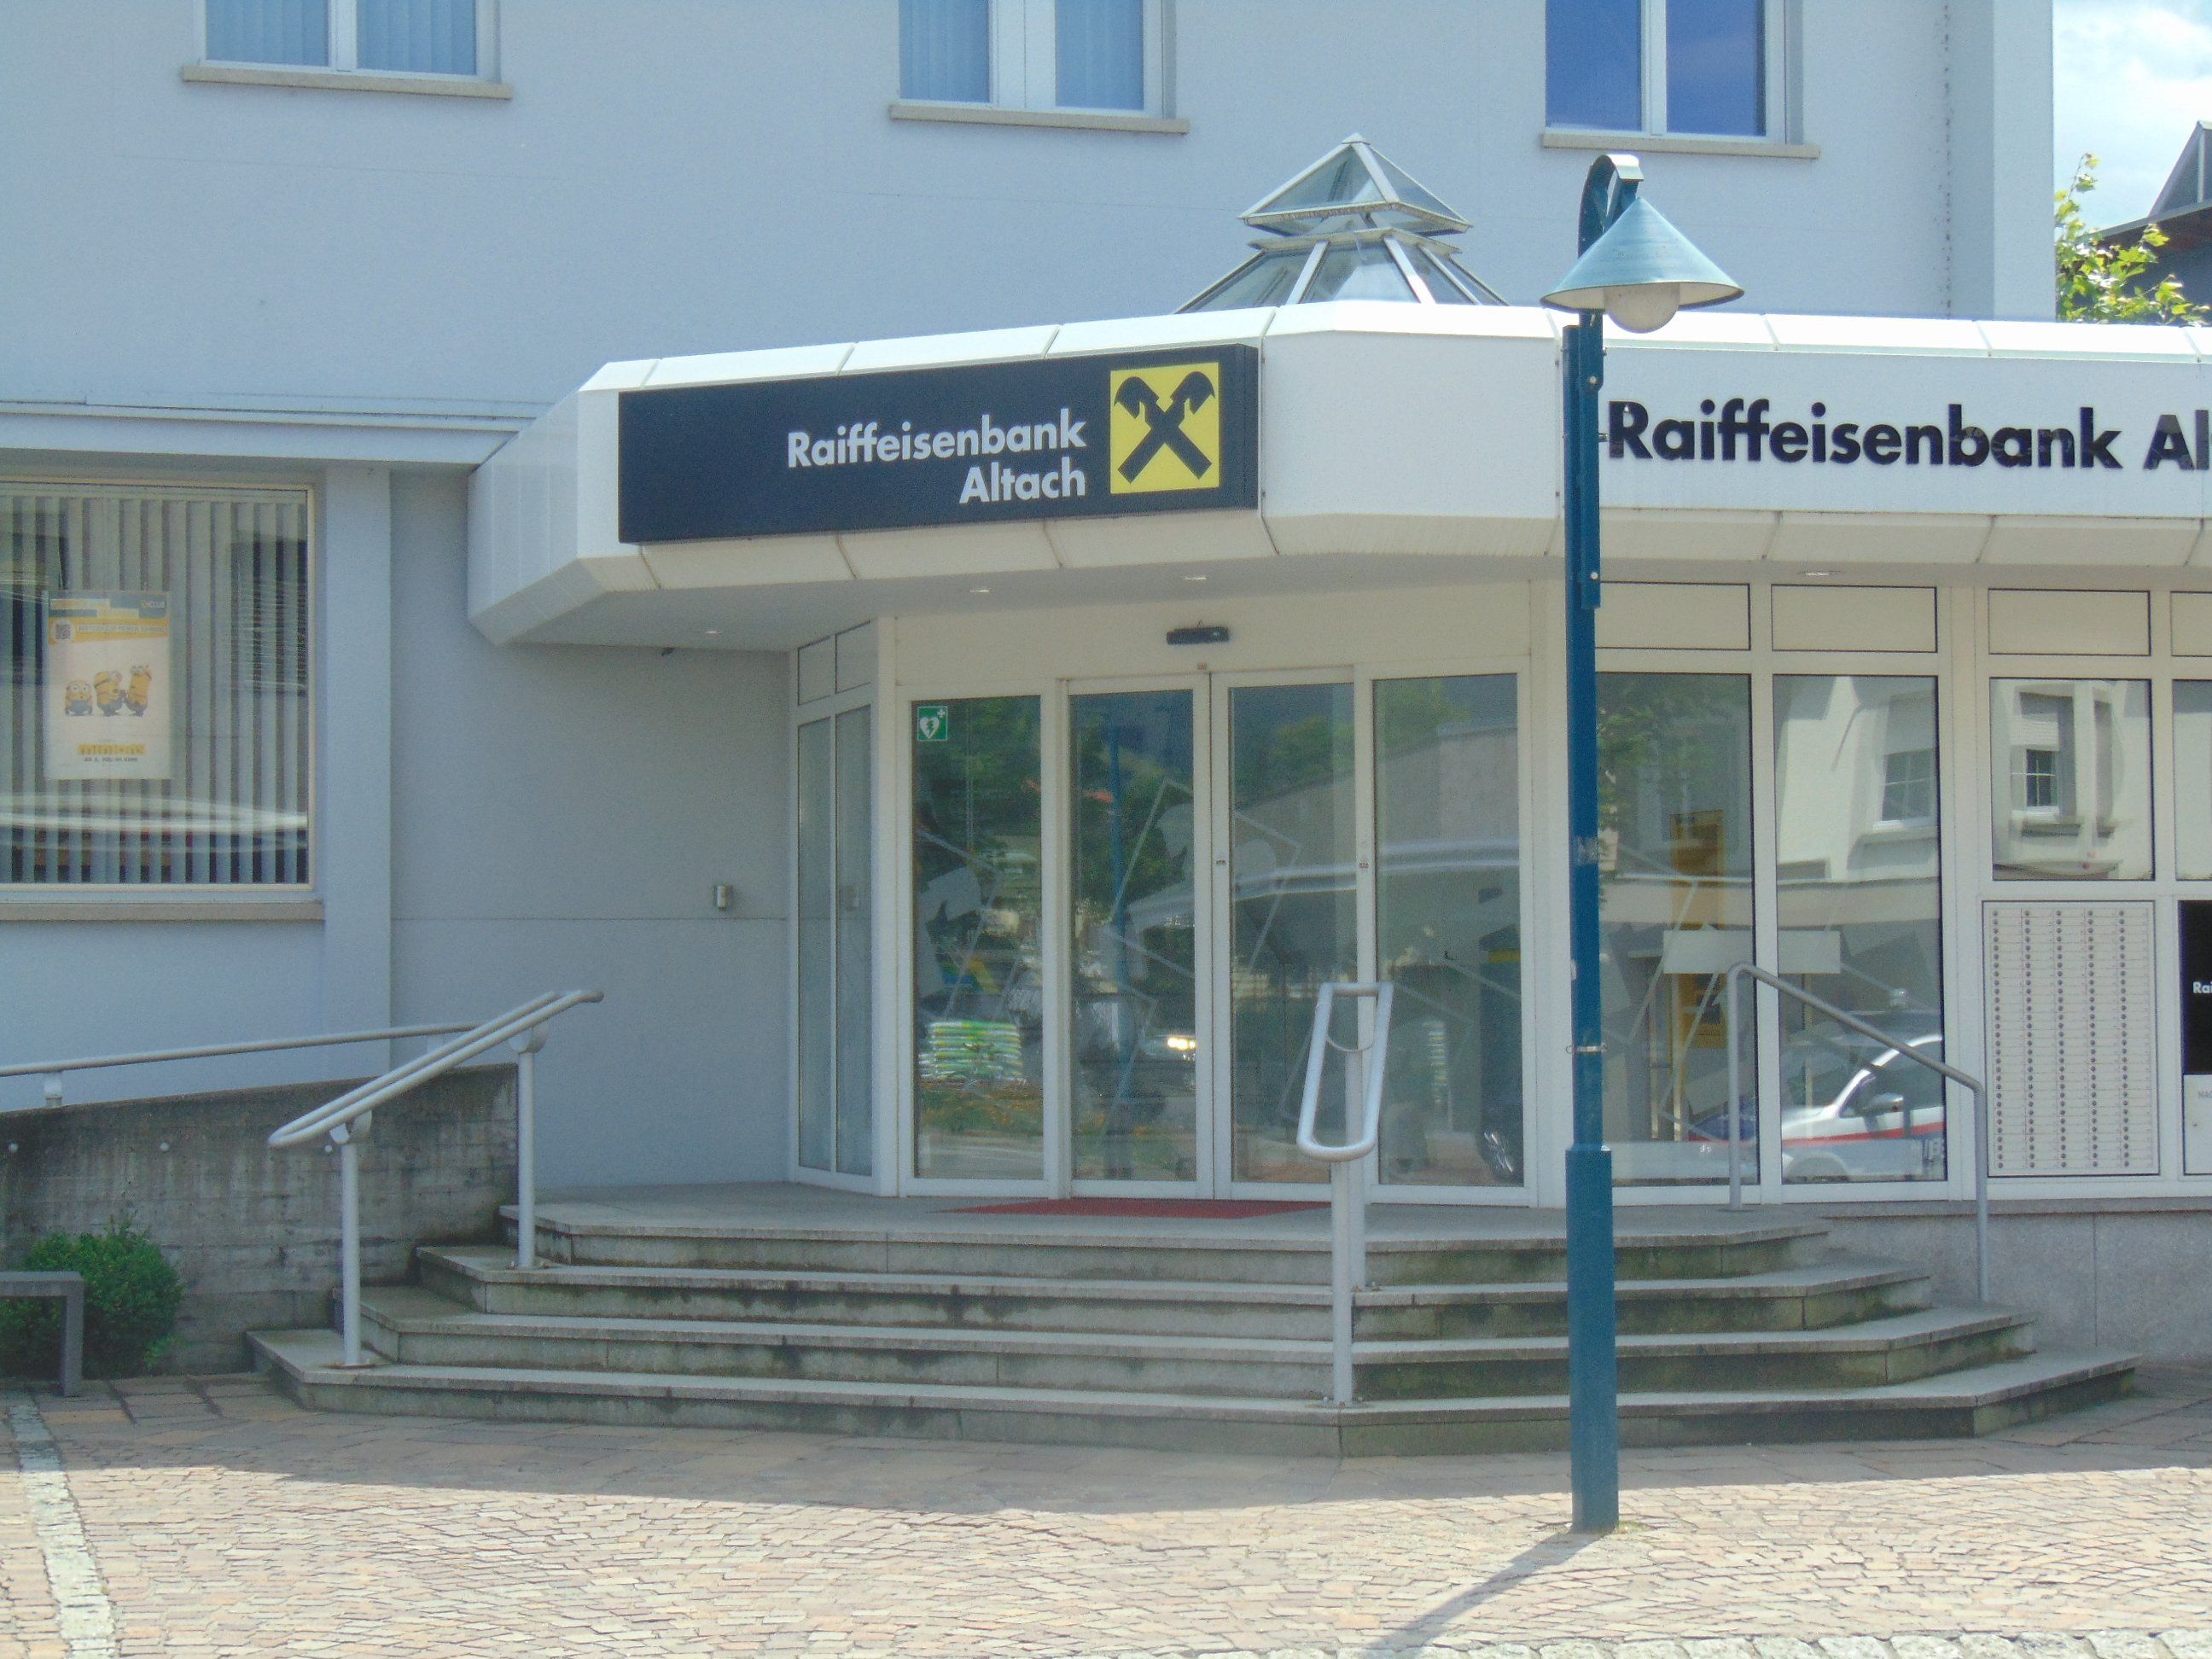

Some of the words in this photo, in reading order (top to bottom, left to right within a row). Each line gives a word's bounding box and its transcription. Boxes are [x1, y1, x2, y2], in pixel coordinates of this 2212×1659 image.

[788, 407, 1087, 468] Raiffeisenbank
[1609, 398, 2123, 469] Raiffeisenbank
[2143, 409, 2210, 470] Al
[959, 457, 1086, 504] Altach
